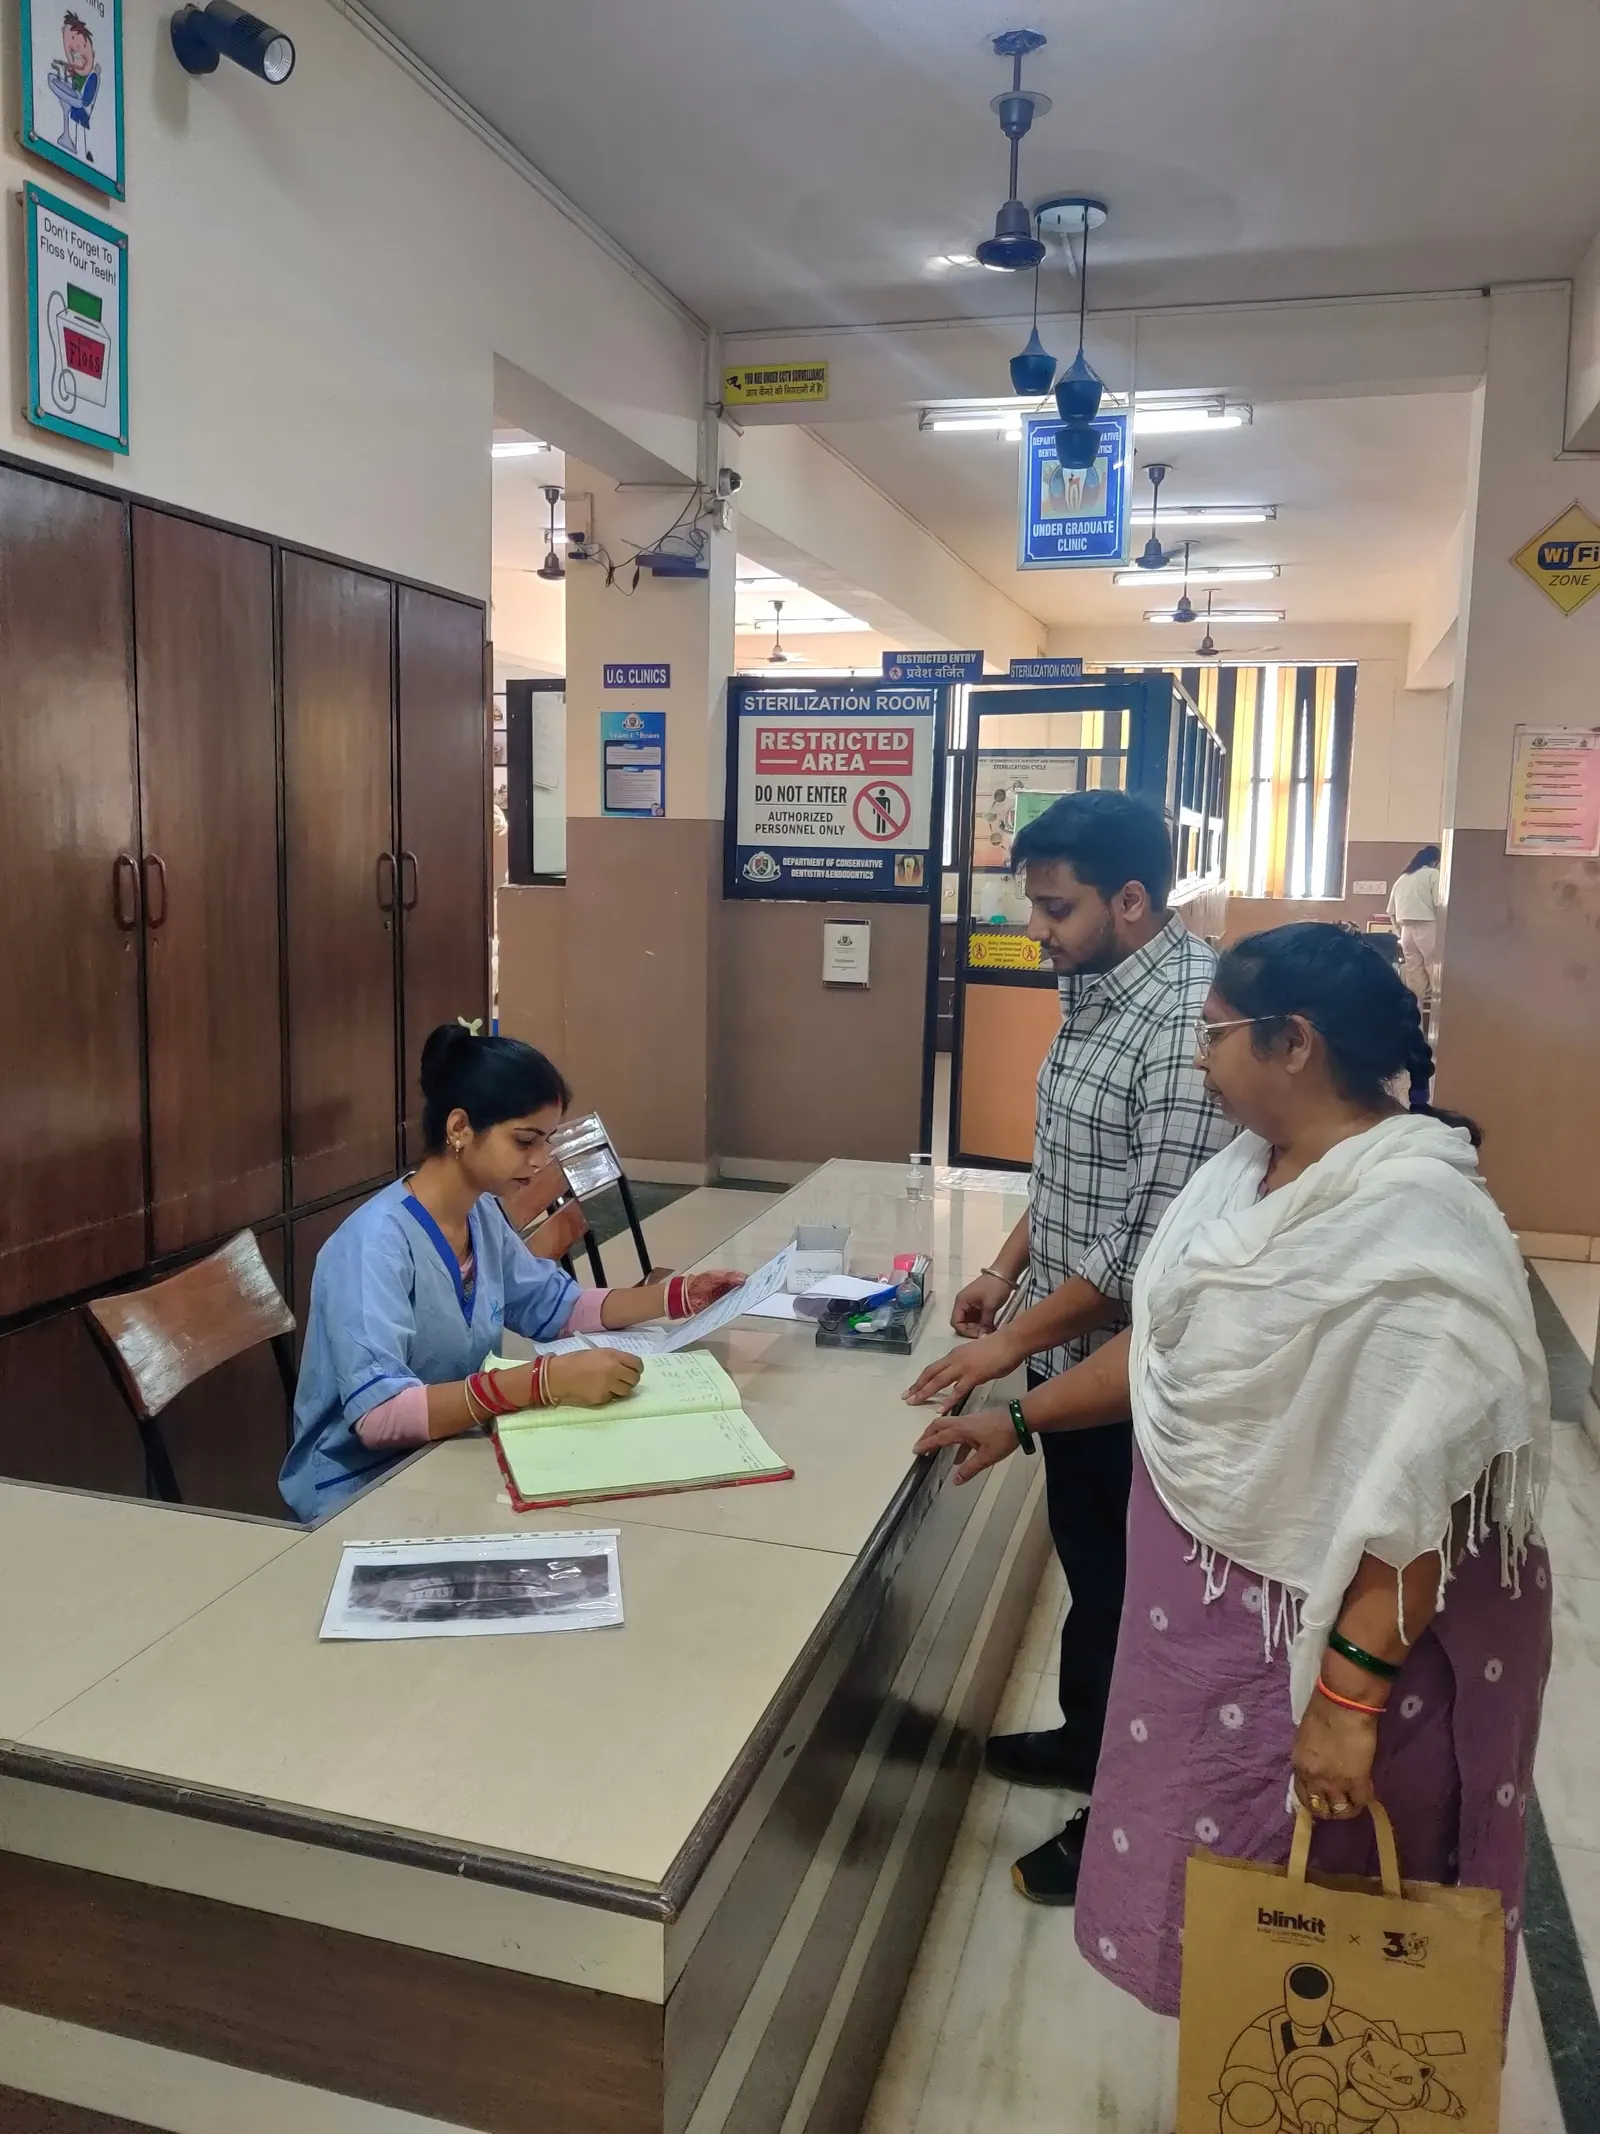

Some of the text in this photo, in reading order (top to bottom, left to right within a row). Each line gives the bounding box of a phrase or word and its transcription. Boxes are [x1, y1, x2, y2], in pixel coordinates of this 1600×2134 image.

[44, 217, 112, 264] Don't Forget To
[40, 235, 117, 286] Floss Your Teeth!
[70, 341, 100, 373] Floss
[1033, 520, 1114, 537] UNDER GRADUATE
[1057, 538, 1087, 552] CLINIC
[1549, 574, 1591, 586] ZONE
[896, 653, 976, 664] RESTRICTED ENTRY
[606, 669, 667, 684] U.G. CLINICS
[906, 664, 965, 679] प्रवेश वर्जित
[1010, 664, 1081, 678] STERILIZATION ROOM
[744, 695, 930, 711] STERILIZATION ROOM
[759, 731, 909, 751] RESTRICTED
[801, 752, 866, 772] AREA
[755, 785, 847, 804] DO NOT ENTER
[768, 811, 833, 823] AUTHORIZED
[755, 824, 845, 836] PERSONNEL ONLY
[782, 857, 883, 869] DEPARTMENT OF CONSERVATIVE
[1257, 1907, 1326, 1936] blinkit
